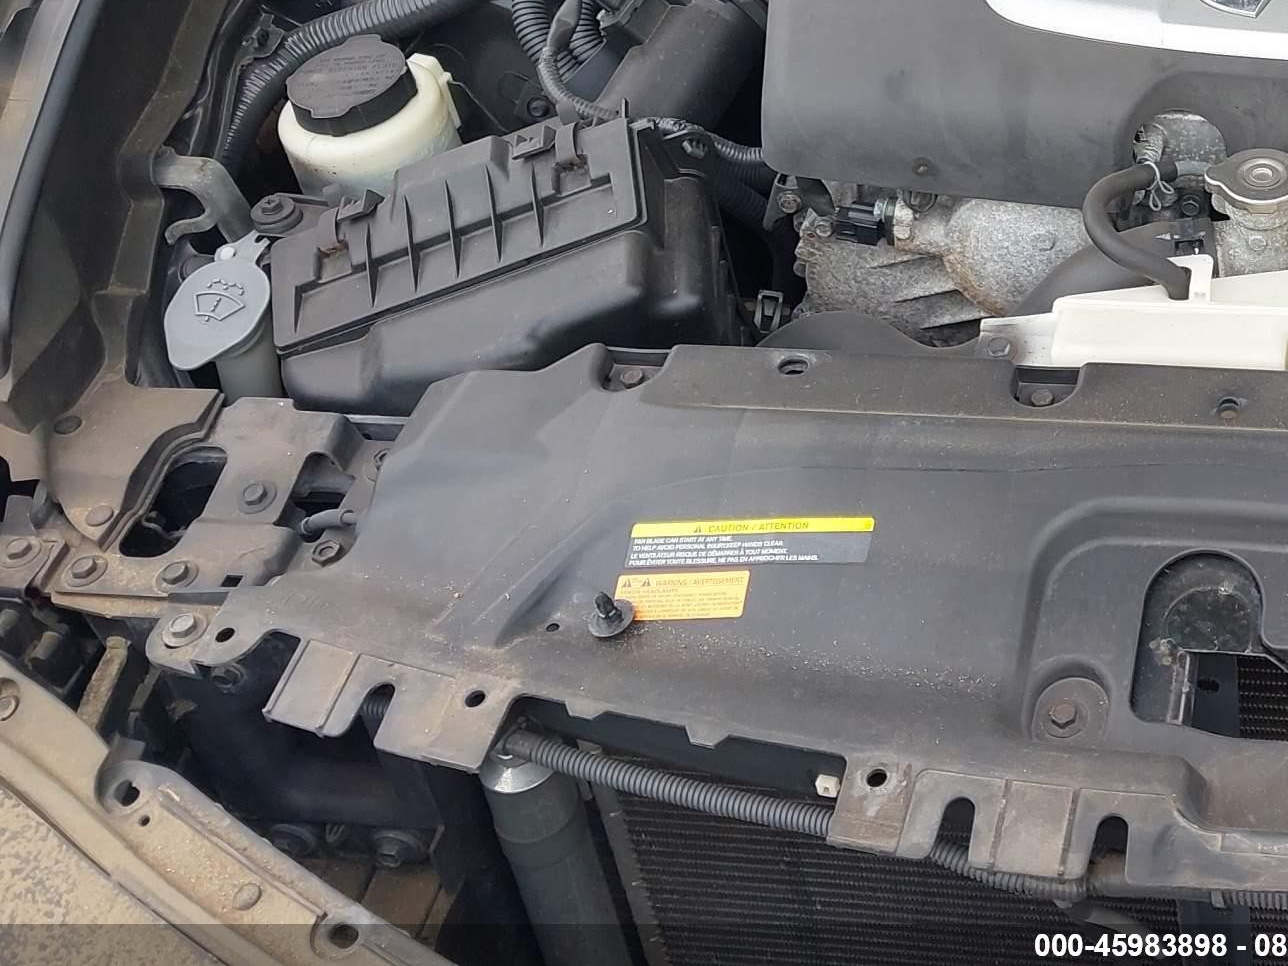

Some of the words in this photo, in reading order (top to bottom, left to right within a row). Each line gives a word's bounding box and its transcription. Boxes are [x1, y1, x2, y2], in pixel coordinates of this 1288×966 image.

[707, 524, 749, 533] CAUTION
[758, 521, 809, 532] ATTENTION
[655, 578, 688, 586] WARNING
